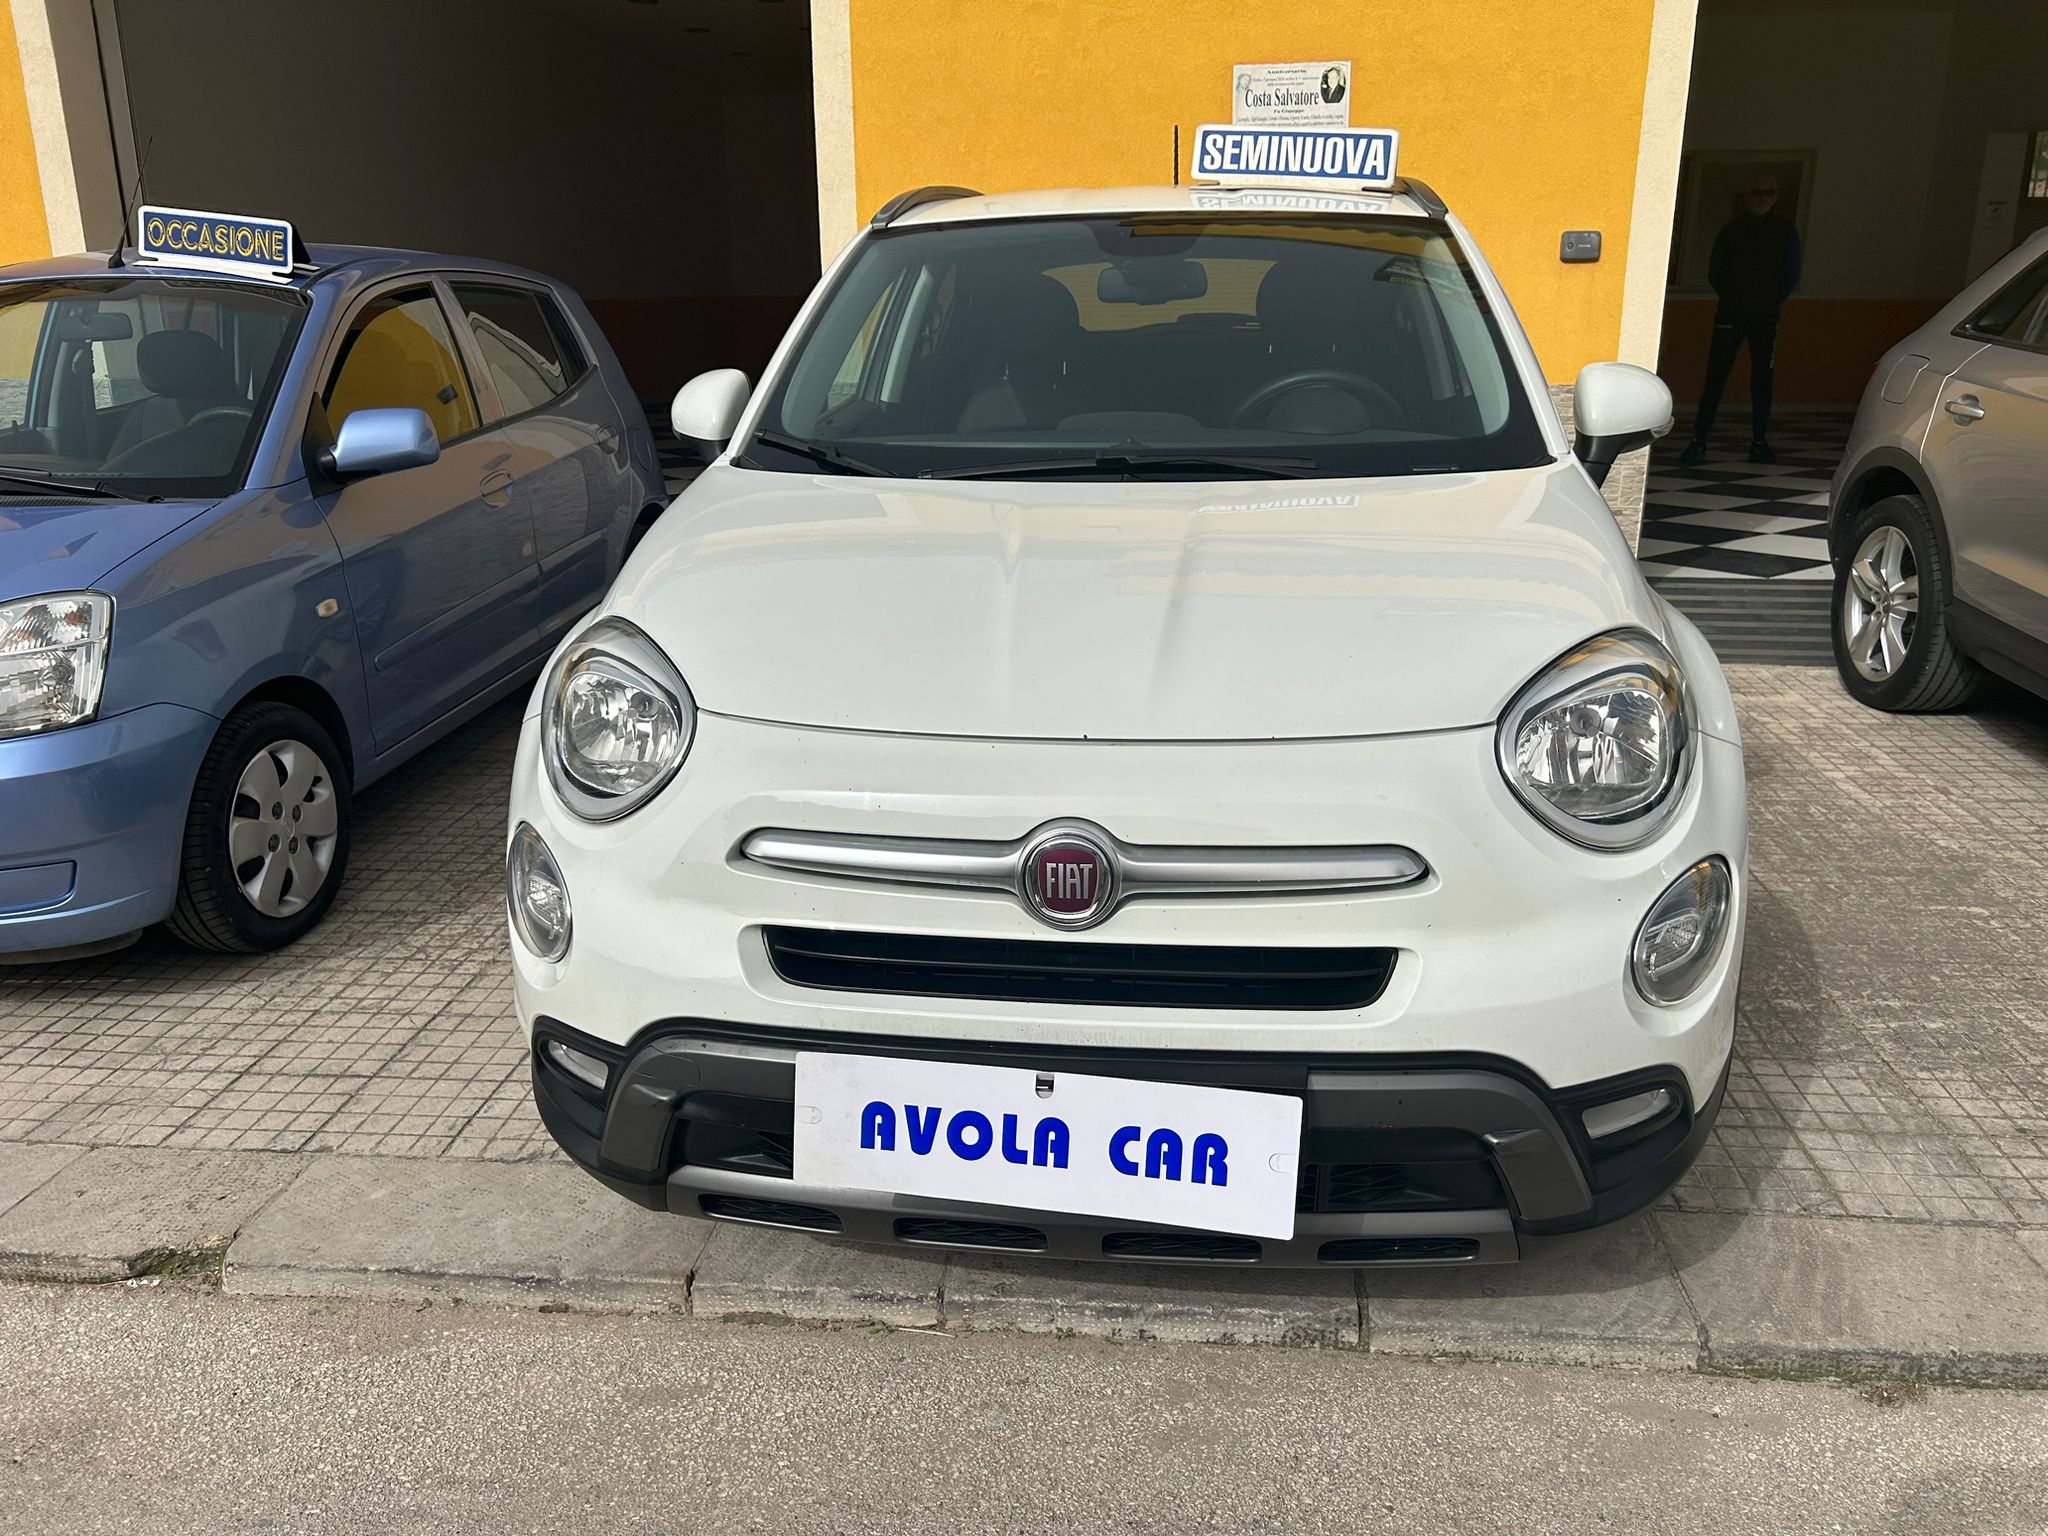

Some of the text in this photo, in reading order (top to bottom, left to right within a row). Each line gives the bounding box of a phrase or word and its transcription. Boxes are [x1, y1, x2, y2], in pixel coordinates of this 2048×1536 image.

[1245, 88, 1320, 108] Costa Salvatore
[1203, 134, 1385, 176] SEMINUOVA
[148, 217, 285, 262] OCCASIONE
[1046, 862, 1093, 900] FIAT
[860, 1101, 1229, 1187] AVOLA CAR
